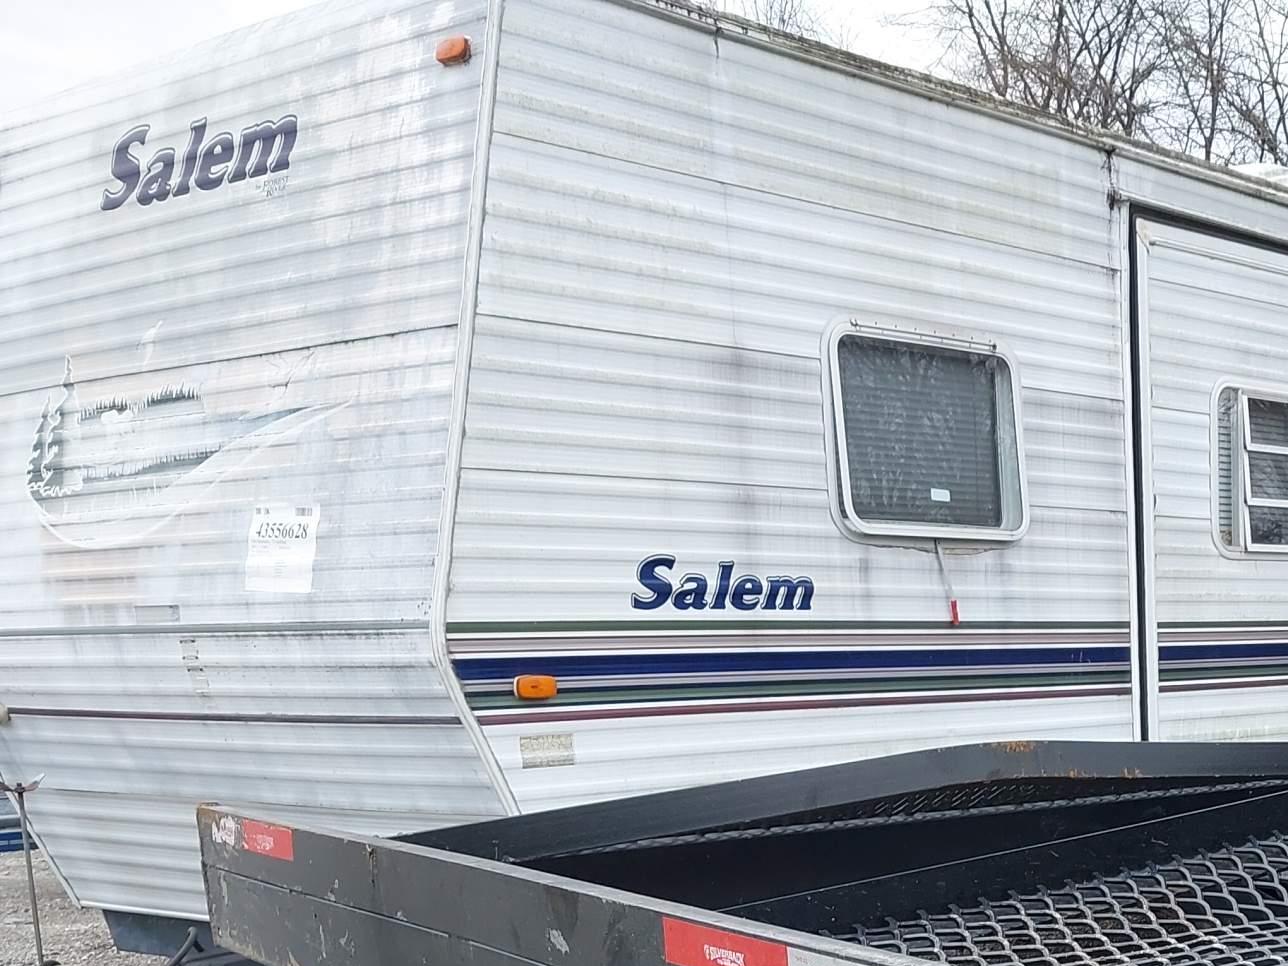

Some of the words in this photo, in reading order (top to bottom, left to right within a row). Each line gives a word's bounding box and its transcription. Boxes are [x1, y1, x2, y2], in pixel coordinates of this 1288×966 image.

[101, 114, 297, 211] Salem
[255, 521, 309, 539] 43556628
[631, 553, 815, 610] Salem
